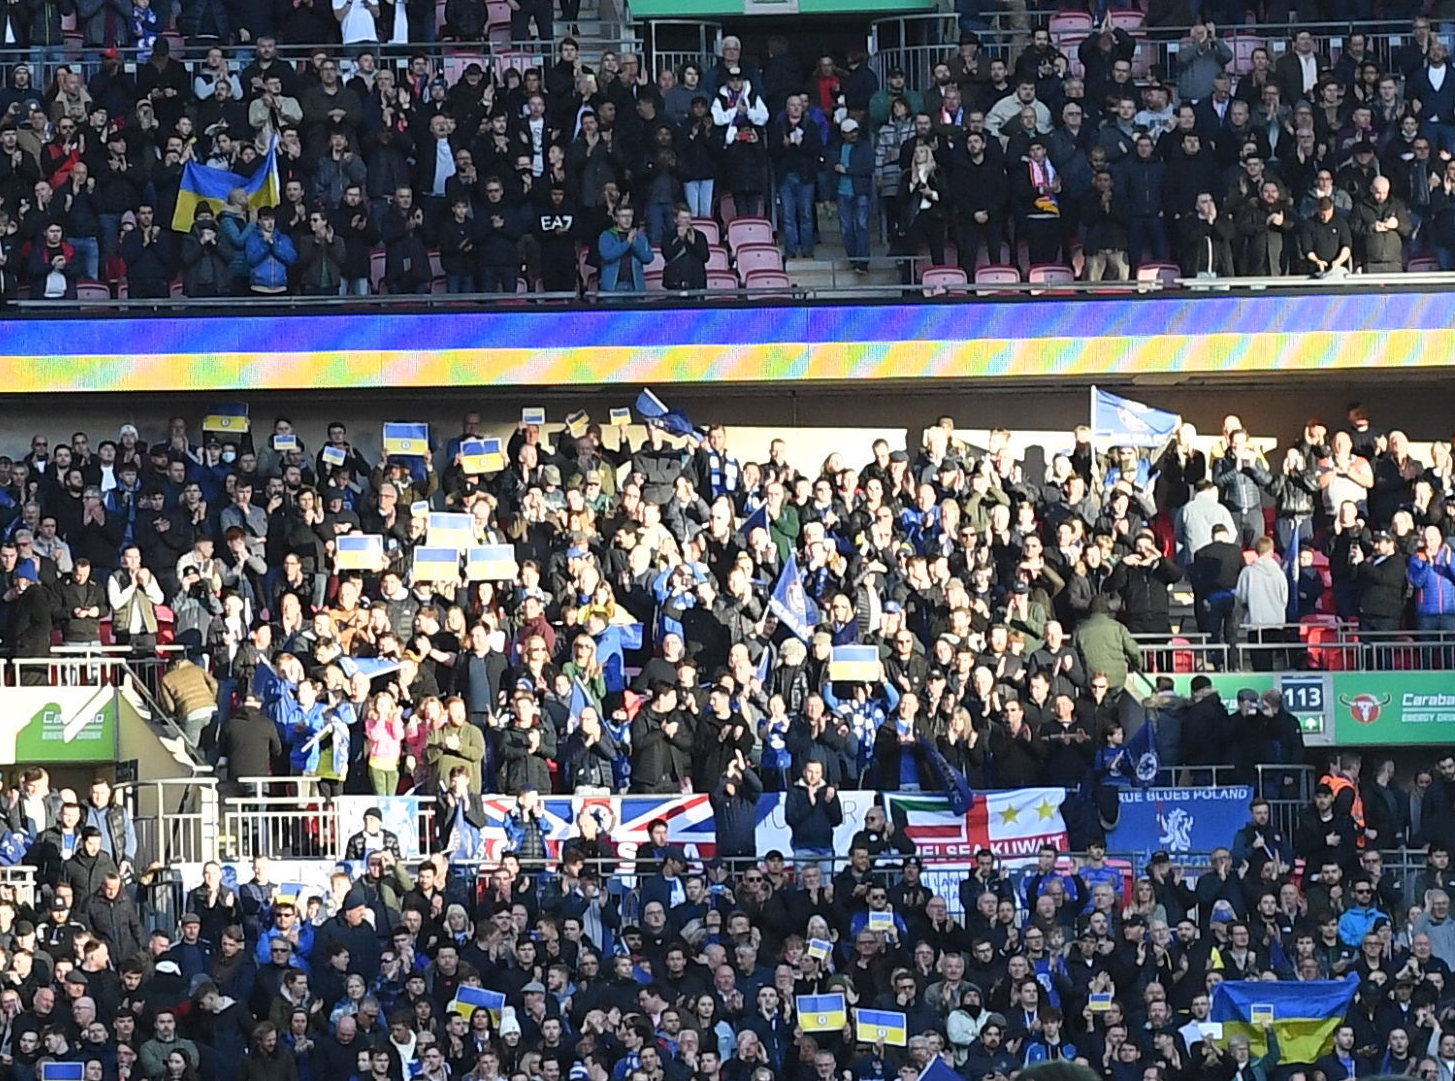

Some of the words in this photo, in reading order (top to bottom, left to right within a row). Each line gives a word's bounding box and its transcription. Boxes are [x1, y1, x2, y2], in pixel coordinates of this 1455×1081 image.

[540, 215, 573, 231] EA7
[1284, 688, 1321, 707] 113
[1402, 693, 1455, 706] Caraba
[1118, 792, 1143, 803] RUE
[1146, 790, 1190, 802] BLUES
[1193, 788, 1248, 800] POLAND
